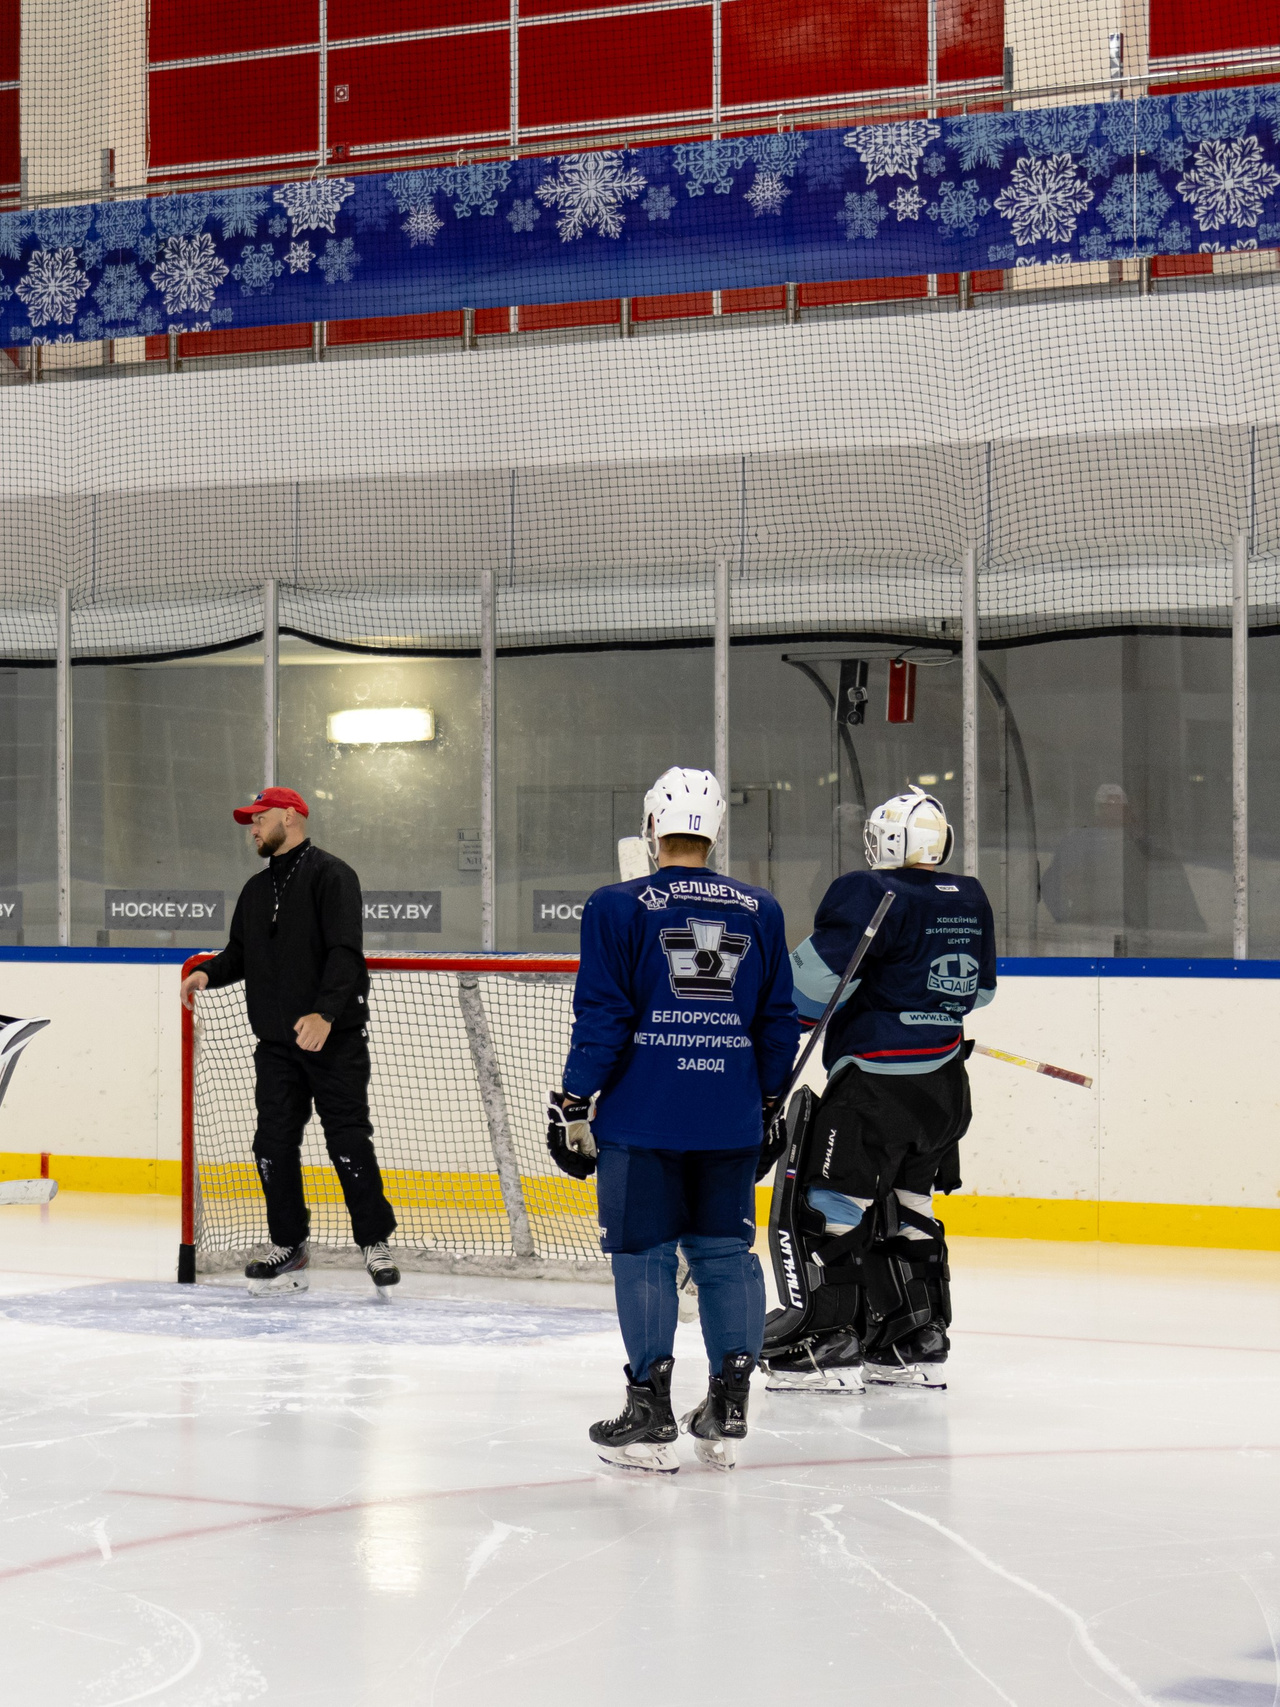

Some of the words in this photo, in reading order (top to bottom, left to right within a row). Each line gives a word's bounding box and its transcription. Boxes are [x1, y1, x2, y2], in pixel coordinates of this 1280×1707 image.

[689, 814, 702, 831] 10
[111, 902, 217, 918] HOCKEY.BY
[363, 904, 433, 919] KEY.BY
[651, 1010, 742, 1026] БЕЛОРУССКИ
[677, 1058, 726, 1073] ЗАВОД
